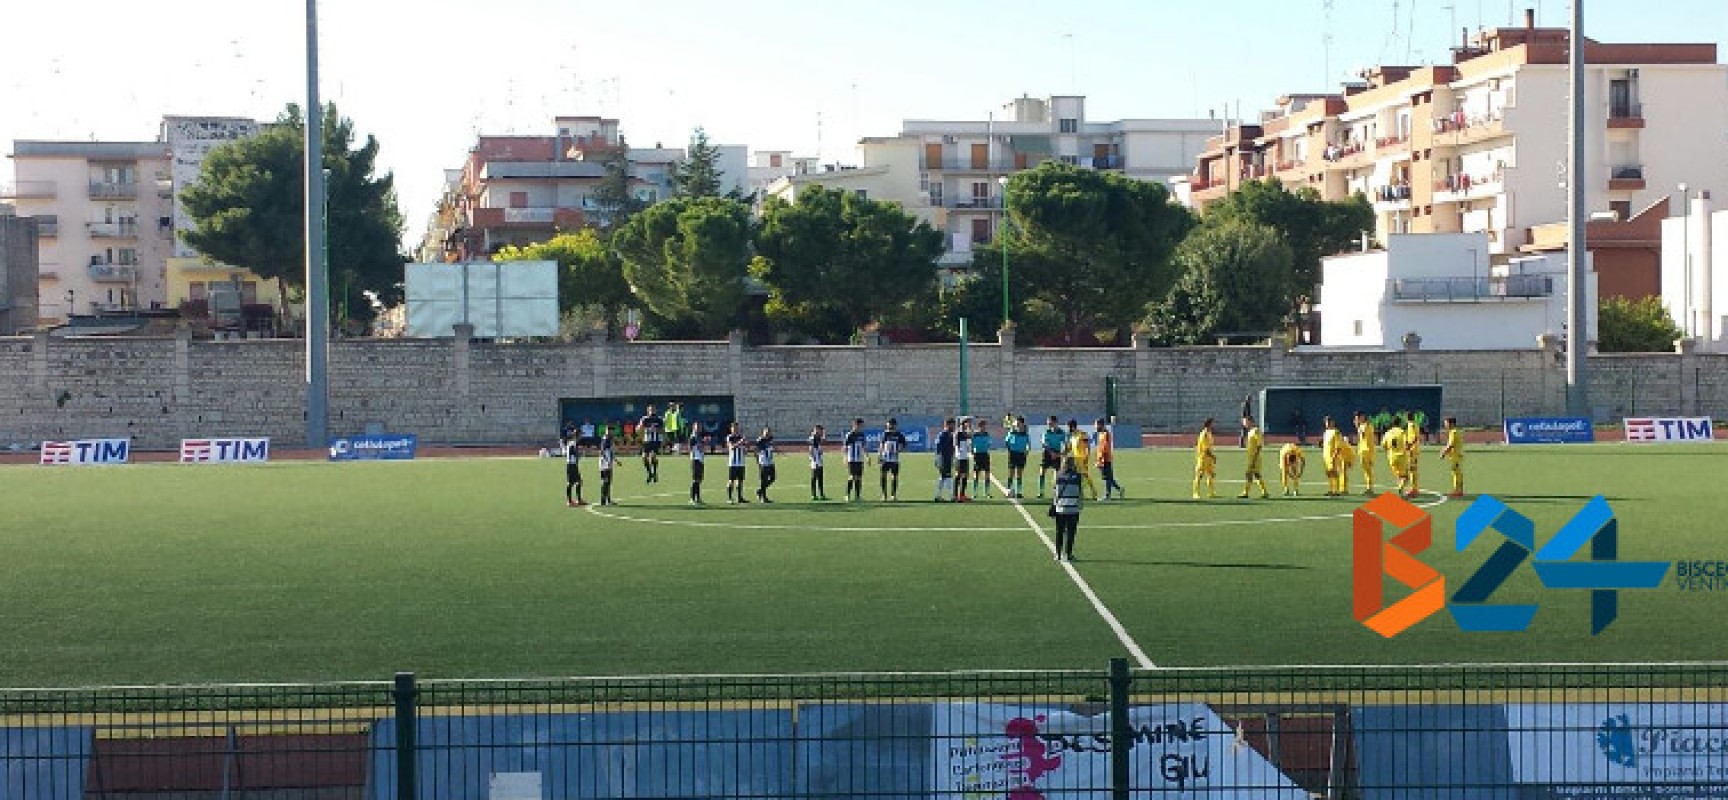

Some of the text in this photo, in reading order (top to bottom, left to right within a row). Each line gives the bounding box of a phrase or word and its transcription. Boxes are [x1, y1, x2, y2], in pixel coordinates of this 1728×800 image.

[1659, 420, 1710, 440] TIM
[76, 440, 126, 462] TIM
[215, 440, 266, 461] TIM
